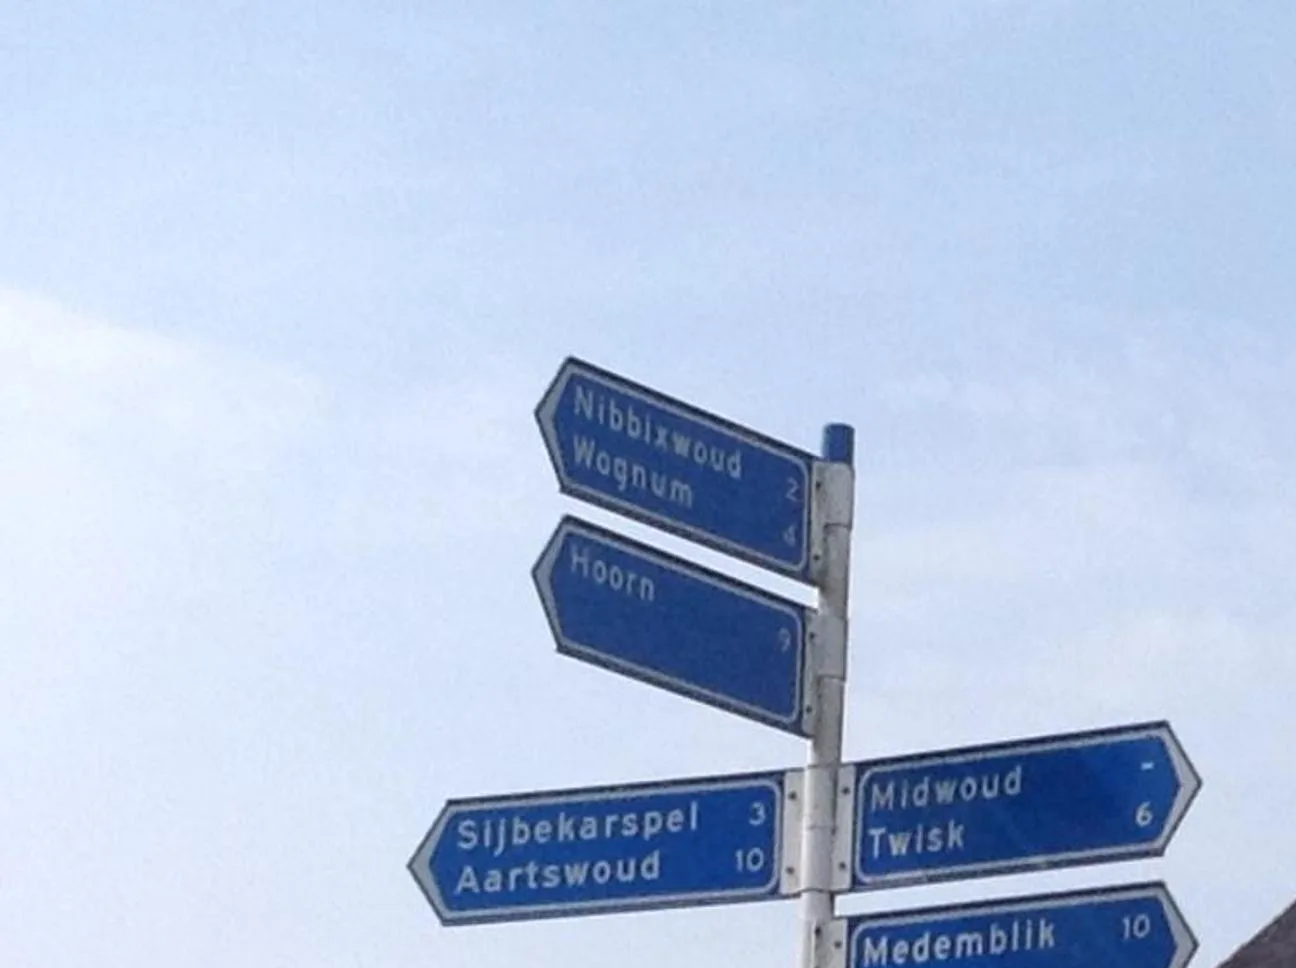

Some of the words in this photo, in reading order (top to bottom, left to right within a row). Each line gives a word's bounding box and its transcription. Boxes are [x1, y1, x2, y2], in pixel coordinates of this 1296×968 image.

[573, 385, 742, 479] Nibbixwoud
[786, 477, 799, 501] 2
[573, 434, 693, 509] Wognum
[570, 543, 655, 602] Hoorn
[870, 765, 1023, 812] Midwoud
[457, 801, 697, 856] Sijbekarspel
[749, 802, 766, 826] 3
[869, 819, 965, 858] Twisk
[1135, 801, 1153, 827] 6
[455, 851, 661, 894] Aartswoud
[734, 847, 765, 873] 10
[862, 918, 1056, 968] Medemblik
[1122, 914, 1151, 939] 10
